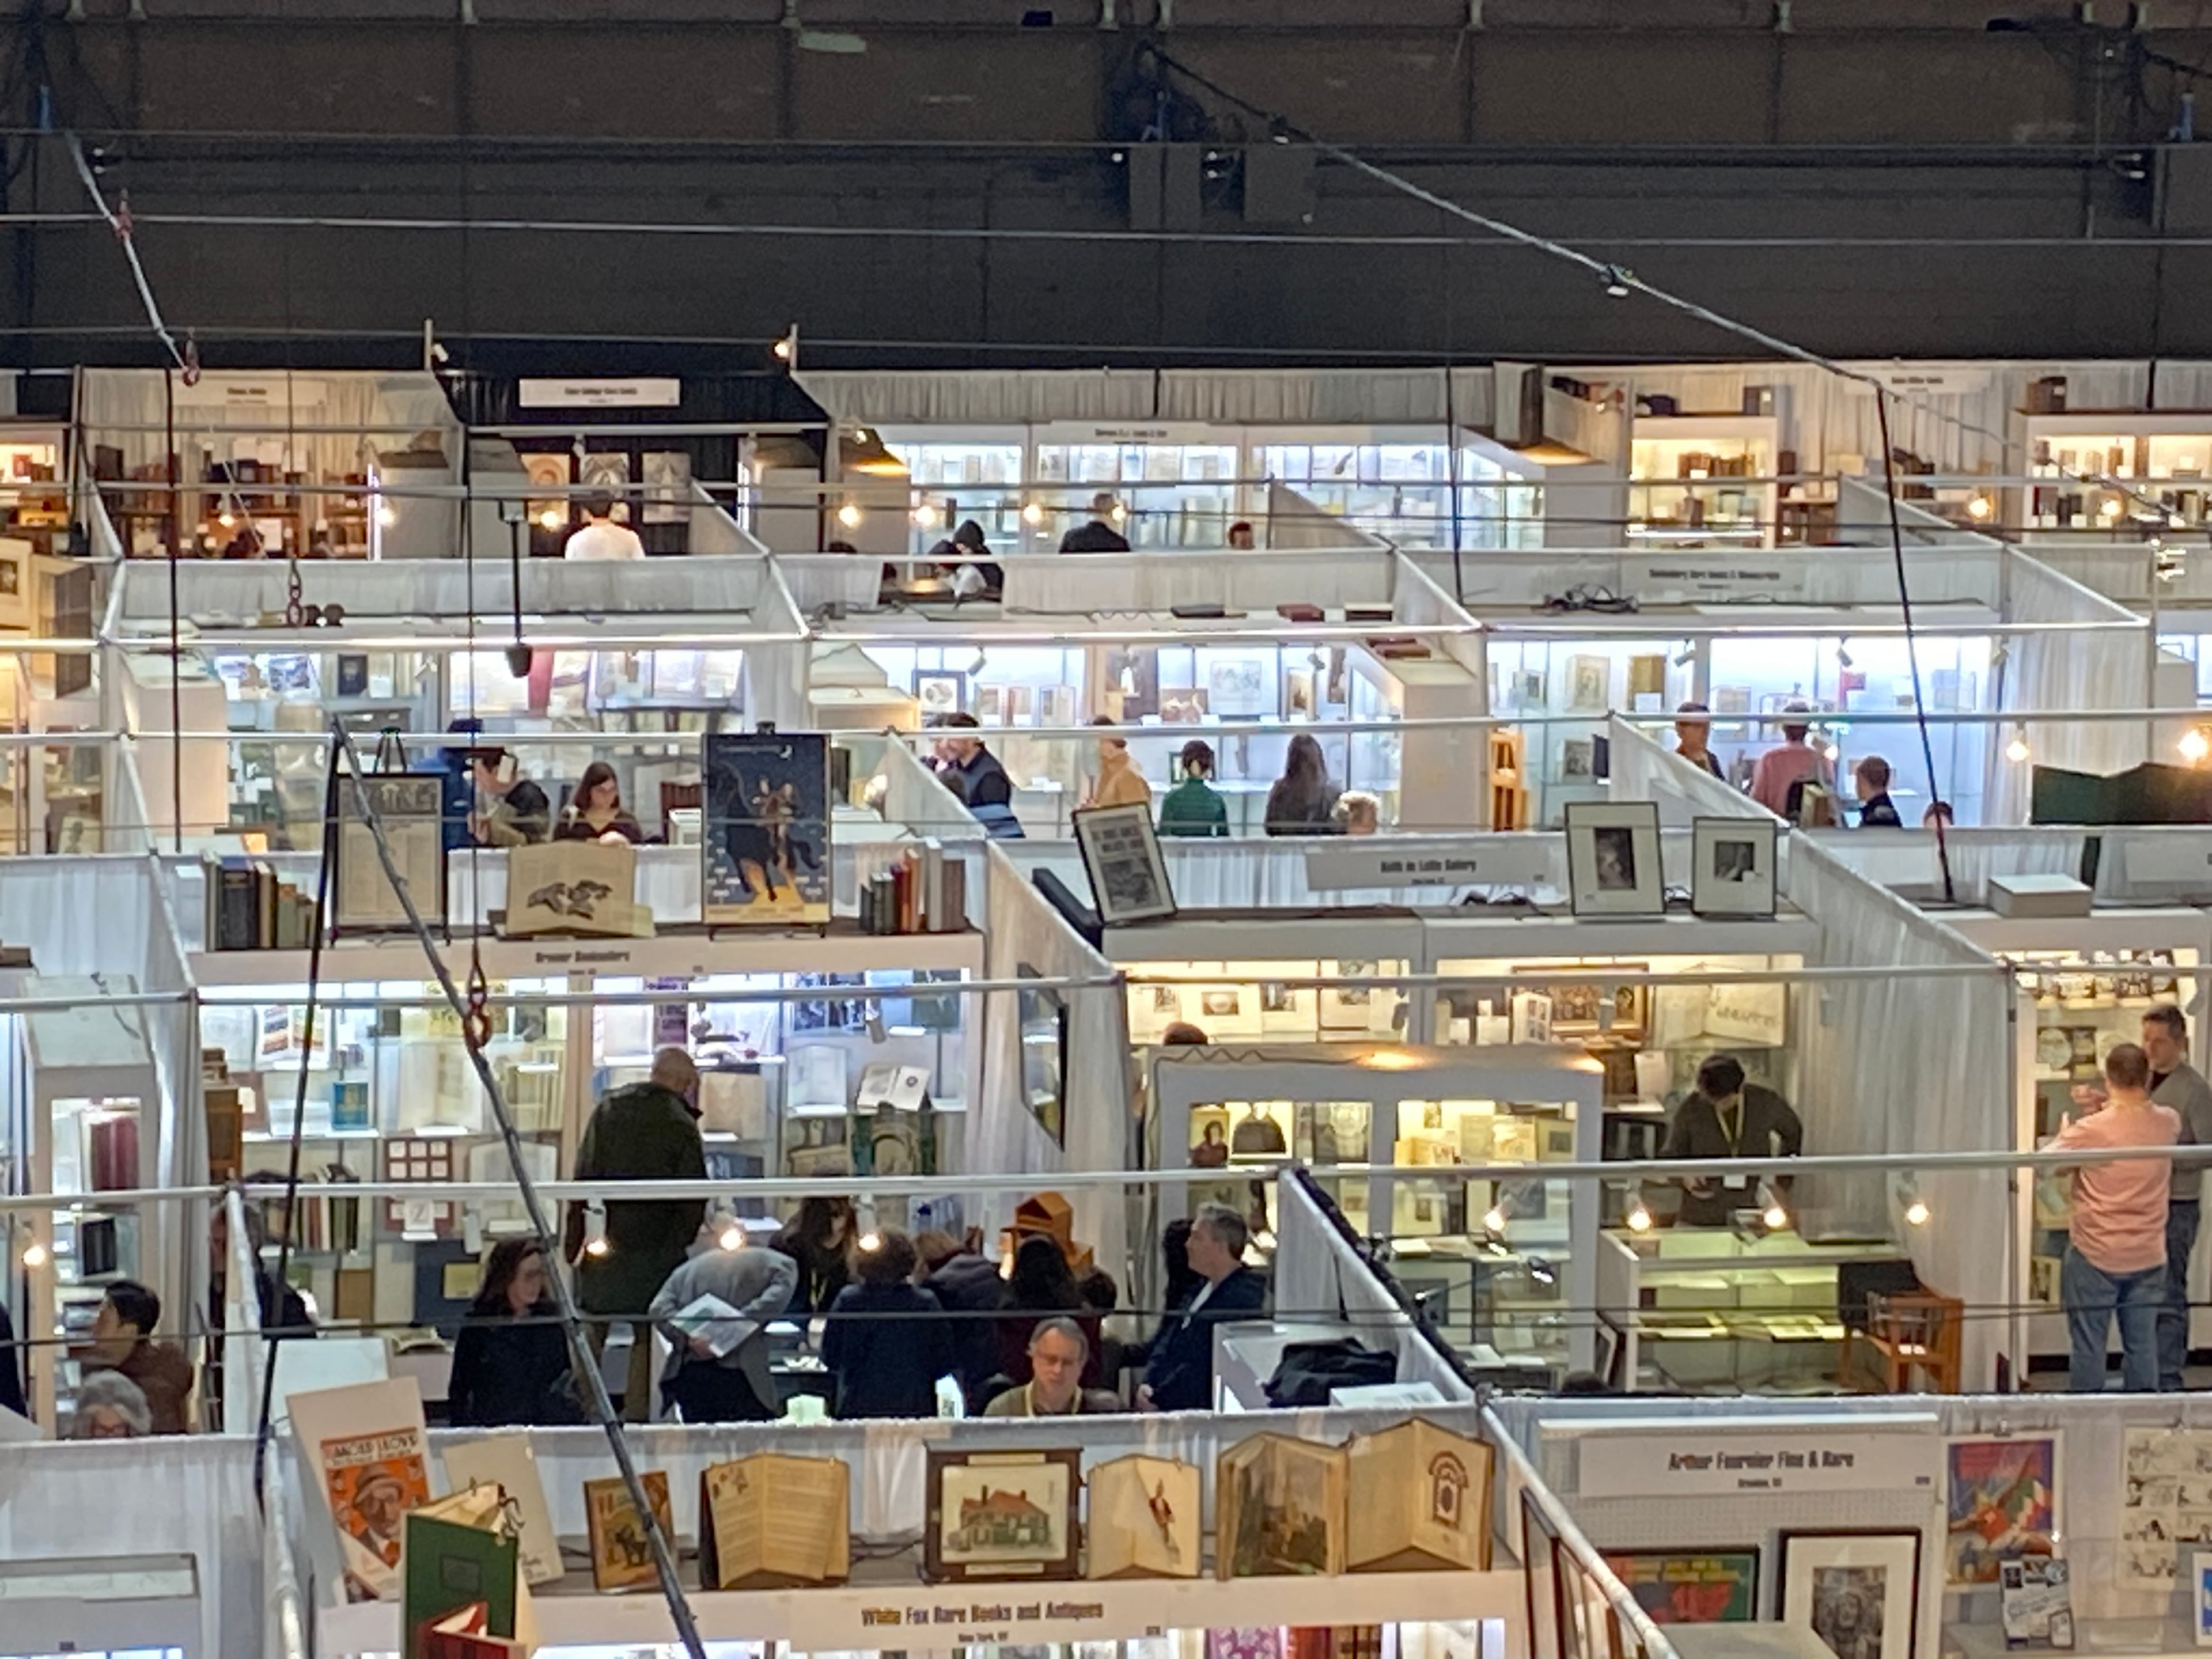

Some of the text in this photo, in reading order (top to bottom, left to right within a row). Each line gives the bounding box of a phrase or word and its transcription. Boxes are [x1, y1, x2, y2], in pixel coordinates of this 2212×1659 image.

[1669, 1452, 1713, 1471] Arthur
[1778, 1450, 1804, 1468] Fine
[1821, 1450, 1854, 1468] Rare
[861, 1606, 901, 1627] White
[906, 1606, 929, 1625] Fox
[933, 1605, 966, 1623] Rare
[971, 1604, 1011, 1623] Books
[1017, 1601, 1041, 1620] and
